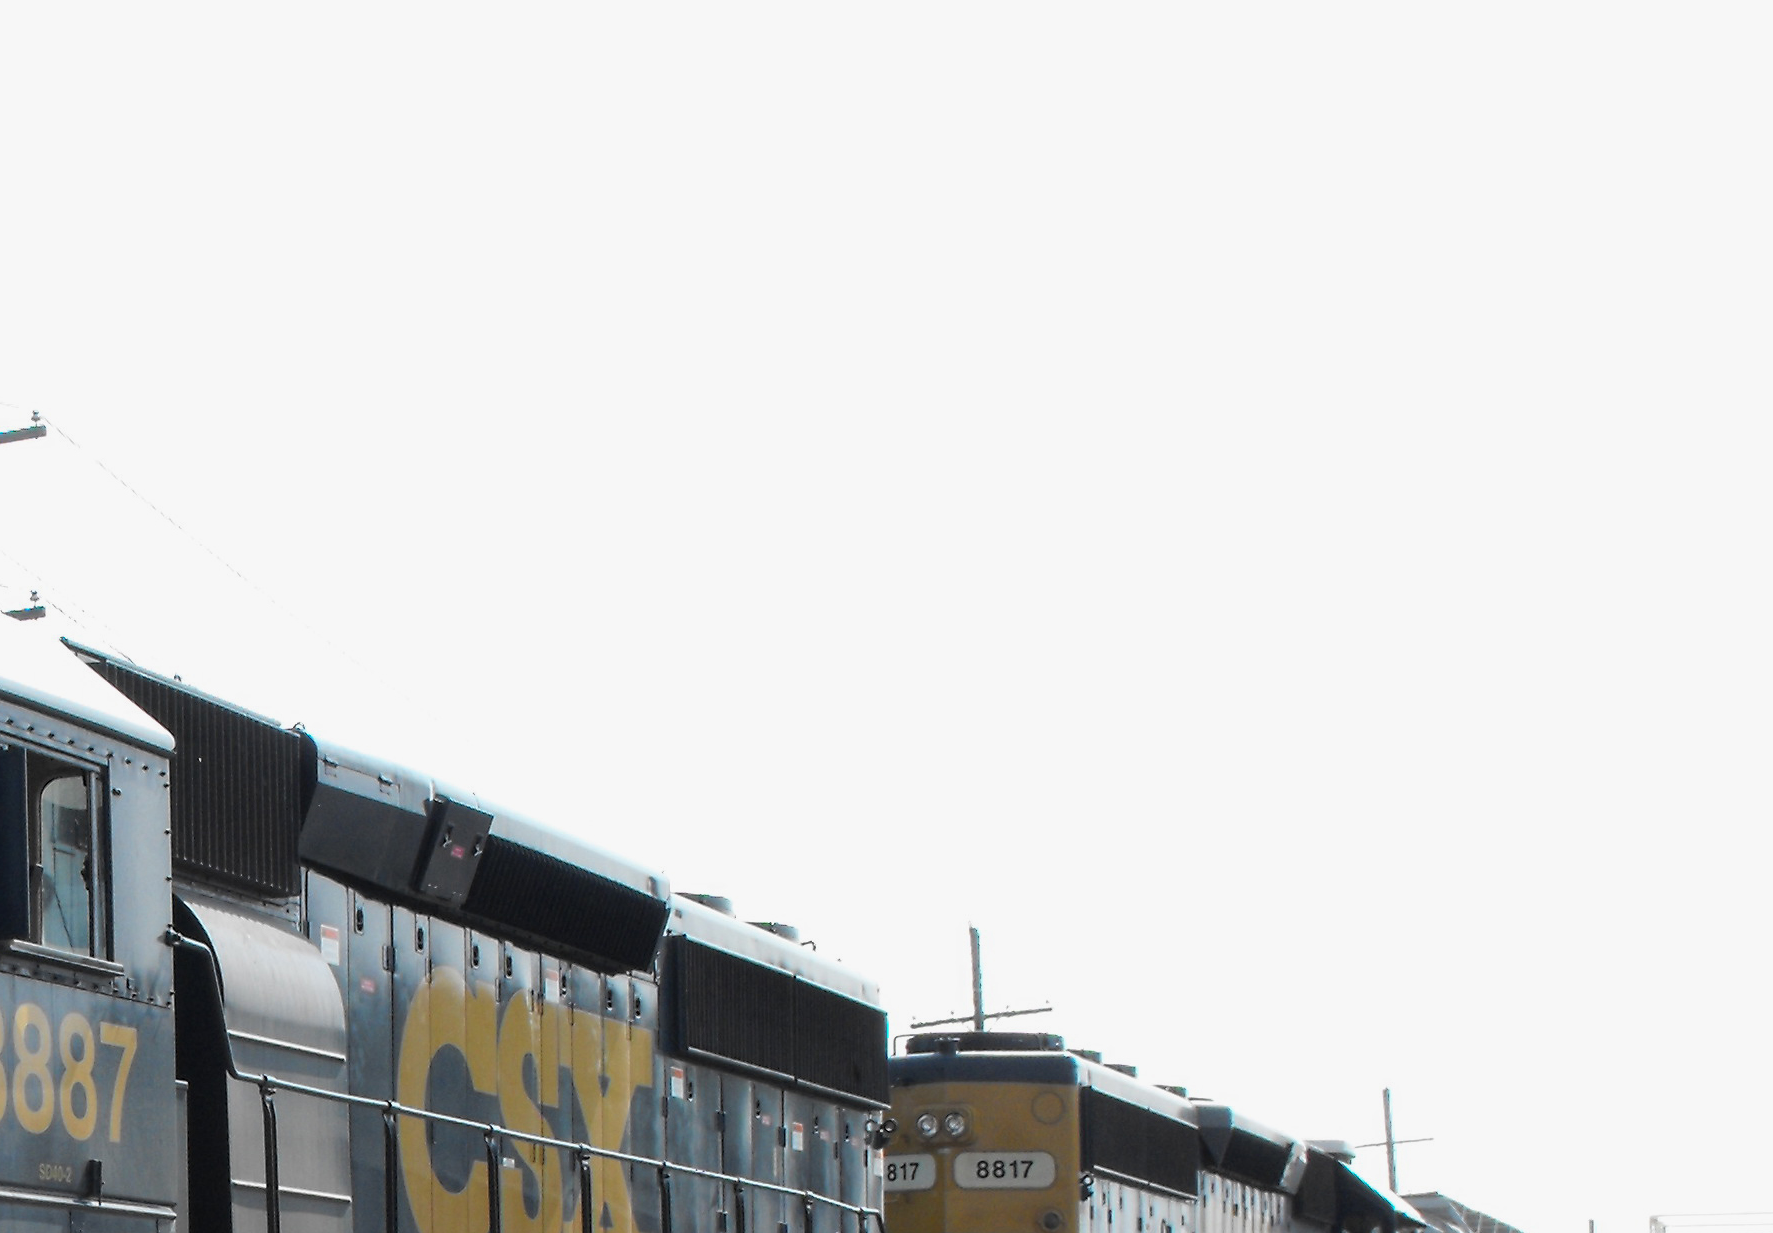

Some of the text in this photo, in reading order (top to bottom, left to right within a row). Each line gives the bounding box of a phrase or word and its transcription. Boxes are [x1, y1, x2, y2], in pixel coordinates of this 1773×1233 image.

[38, 1162, 73, 1184] SD40-2
[887, 1162, 919, 1182] 817
[976, 1160, 1034, 1179] 8817
